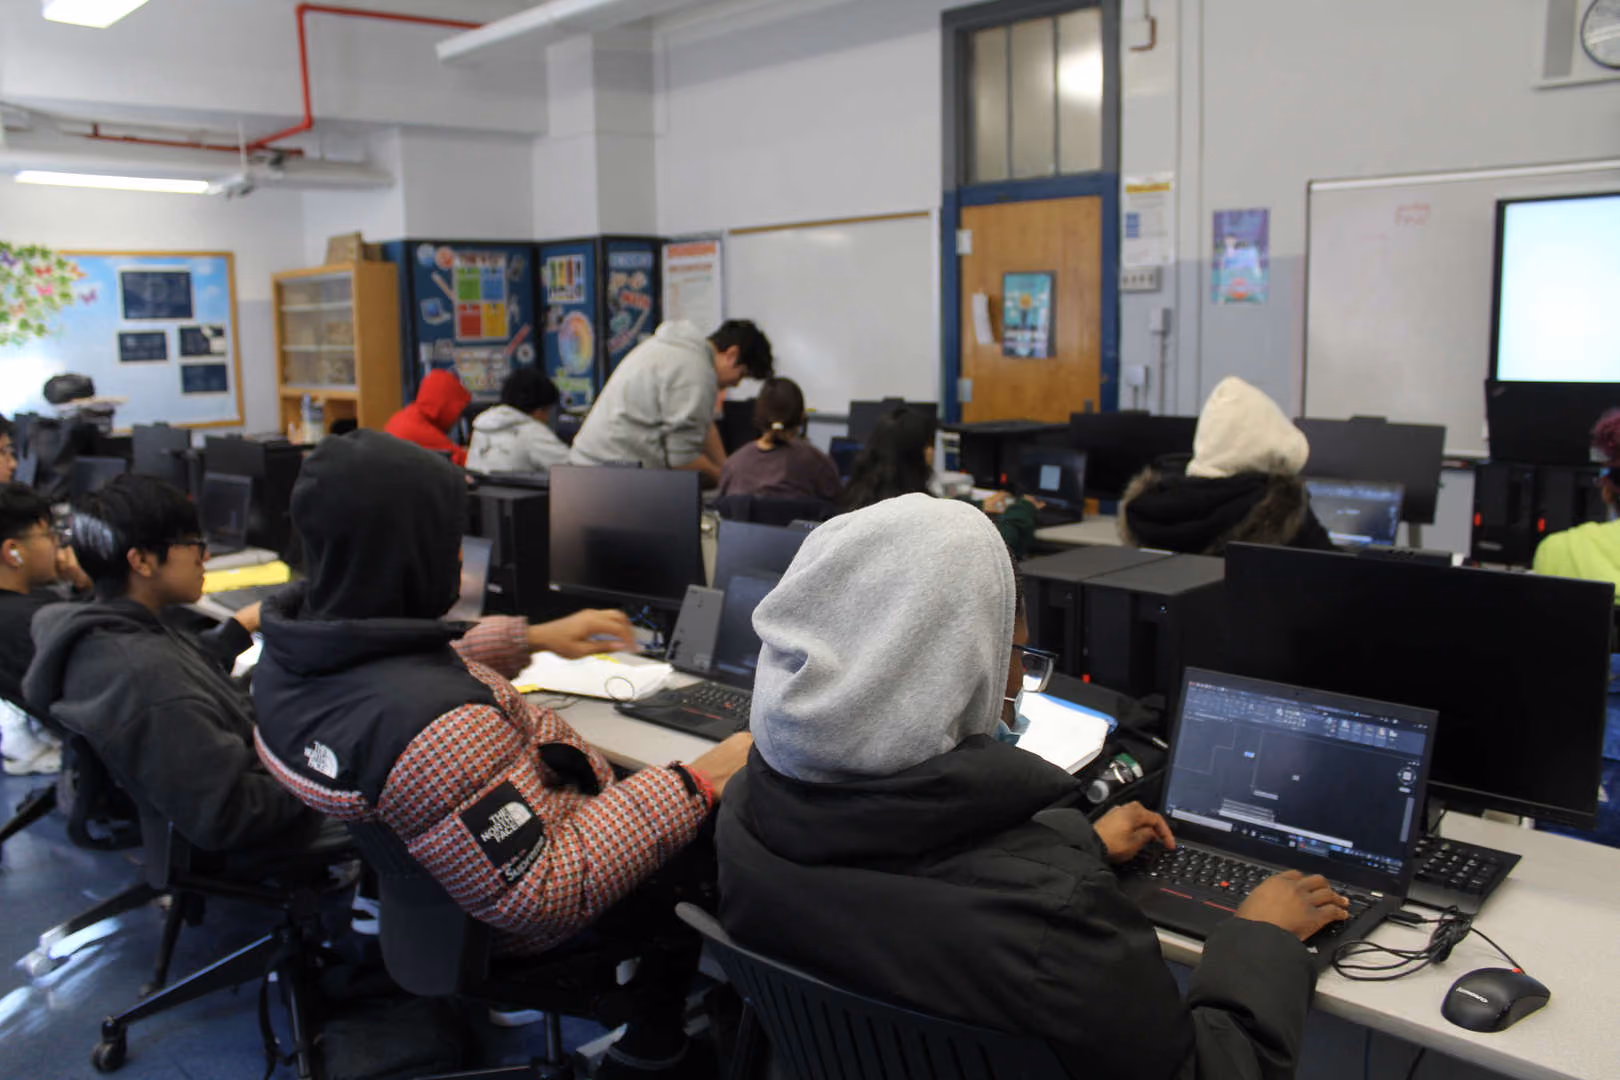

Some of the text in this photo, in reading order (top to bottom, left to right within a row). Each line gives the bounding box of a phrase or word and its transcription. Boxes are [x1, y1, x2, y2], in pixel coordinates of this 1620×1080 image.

[488, 807, 510, 825] THE
[480, 815, 514, 842] NORTH
[494, 822, 519, 843] FACE
